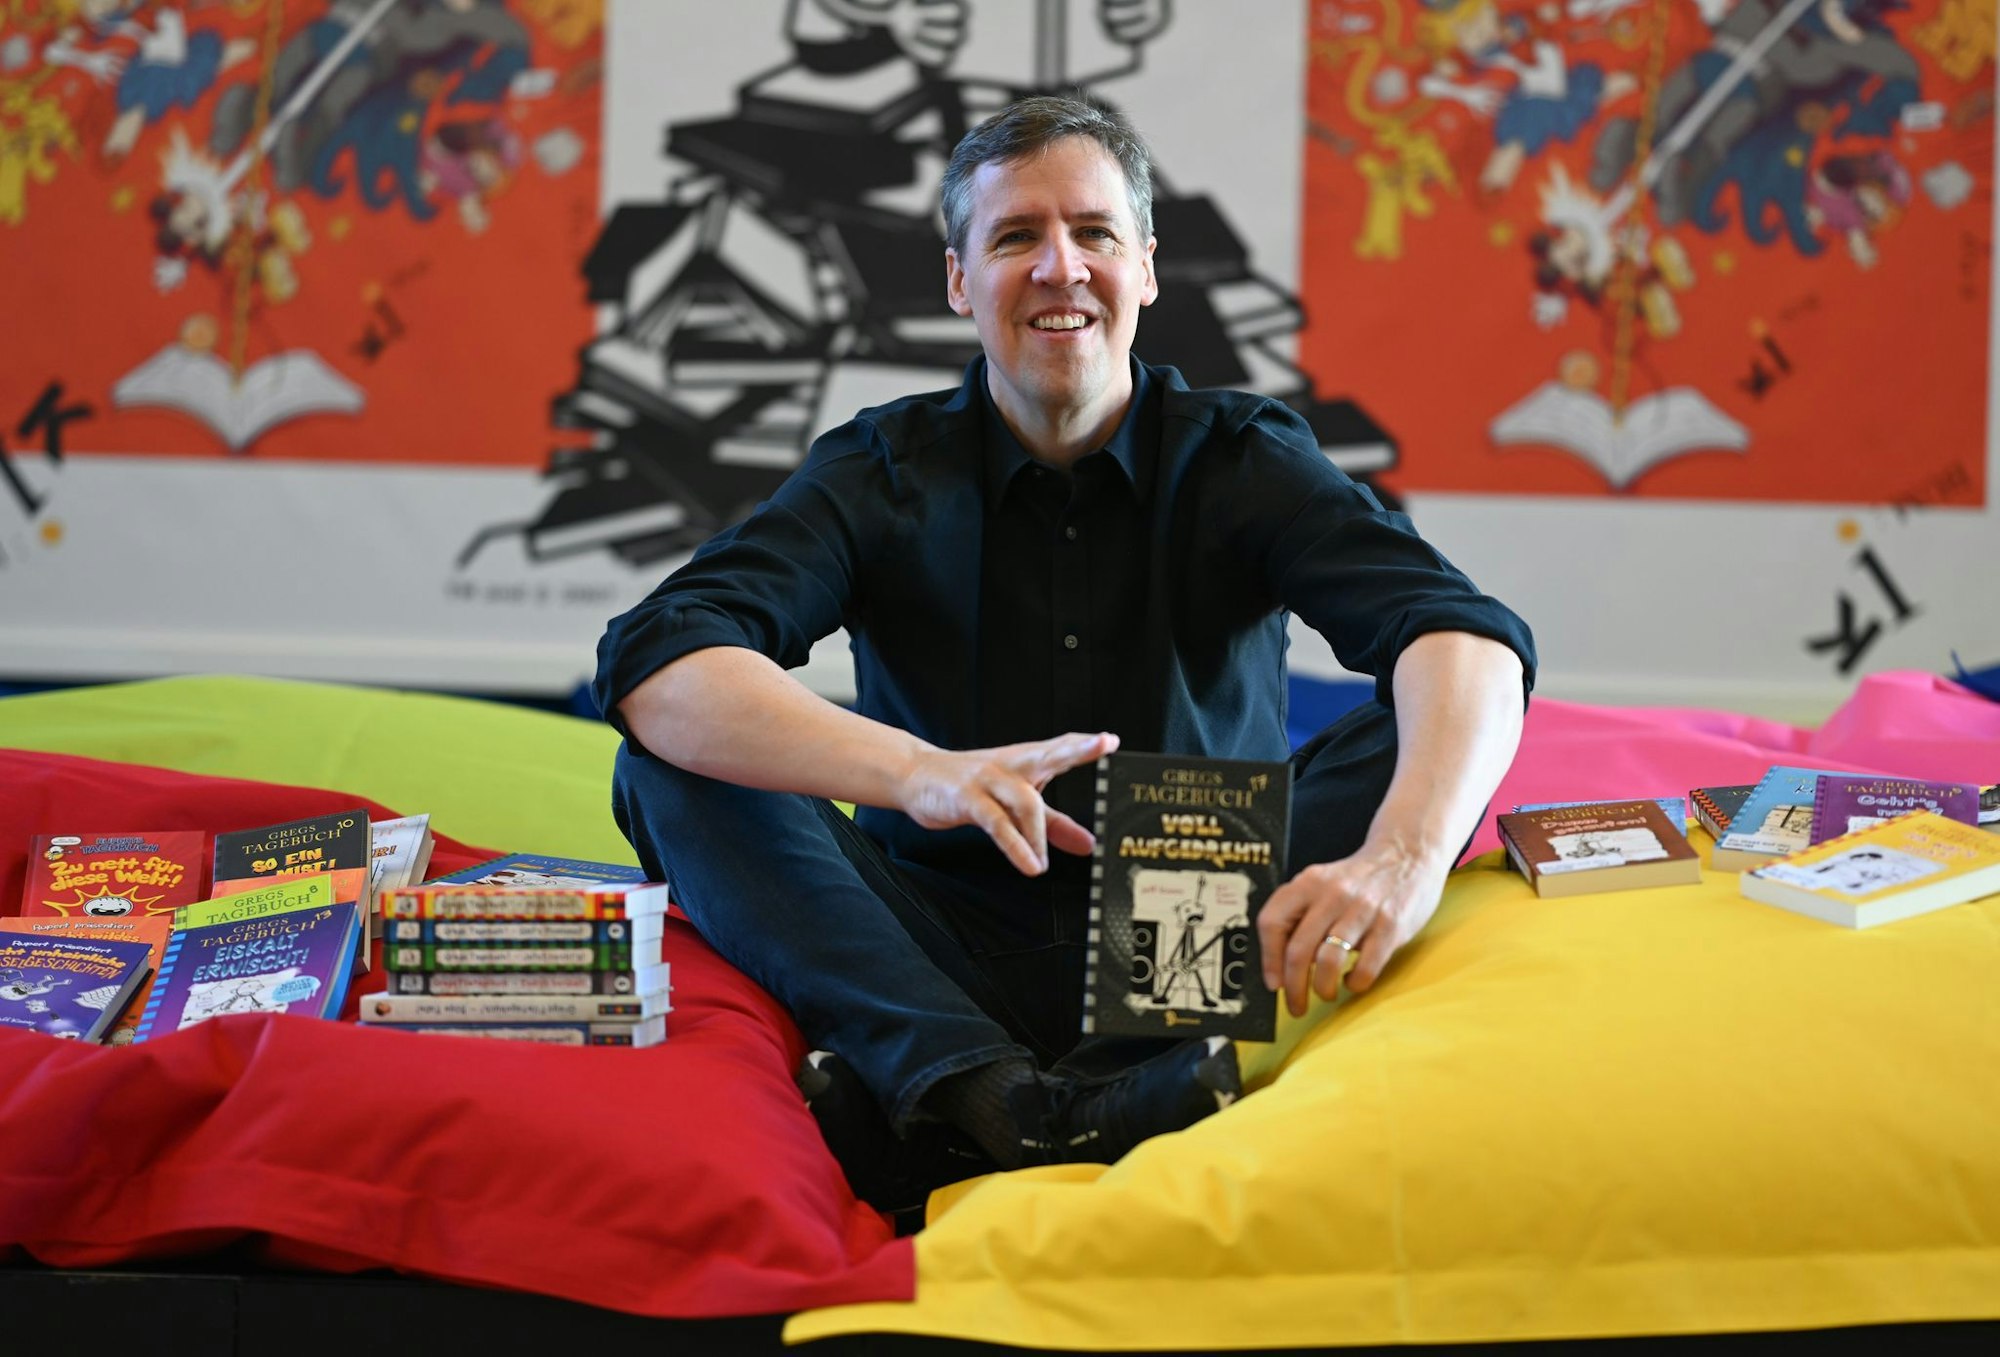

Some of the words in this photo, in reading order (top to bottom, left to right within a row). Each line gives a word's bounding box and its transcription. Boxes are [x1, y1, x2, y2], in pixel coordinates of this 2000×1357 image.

[1162, 768, 1224, 785] GREGS
[1129, 783, 1252, 809] TAGEBUCH
[268, 824, 316, 841] GREGS
[1161, 812, 1224, 837] VOLL
[242, 829, 341, 855] TAGEBUCH
[337, 819, 354, 829] 10
[252, 857, 278, 875] SO
[285, 848, 323, 865] EIN
[1119, 836, 1271, 868] AUFGEDREHT!
[48, 861, 85, 877] Zu
[89, 857, 140, 872] nett
[143, 856, 184, 873] für
[49, 873, 109, 891] diese
[114, 869, 183, 888] Welt!
[206, 893, 311, 924] TAGEBUCH
[234, 890, 284, 908] GREGS
[32, 922, 70, 931] Rupert
[200, 920, 316, 948] TAGEBUCH
[314, 909, 333, 921] 13
[233, 917, 289, 933] GREGS
[12, 939, 49, 948] Rupert
[53, 942, 112, 954] präsentiert
[214, 933, 299, 963] EISKALT
[31, 949, 126, 969] unheimliche
[192, 947, 310, 981] ERWISCHT!
